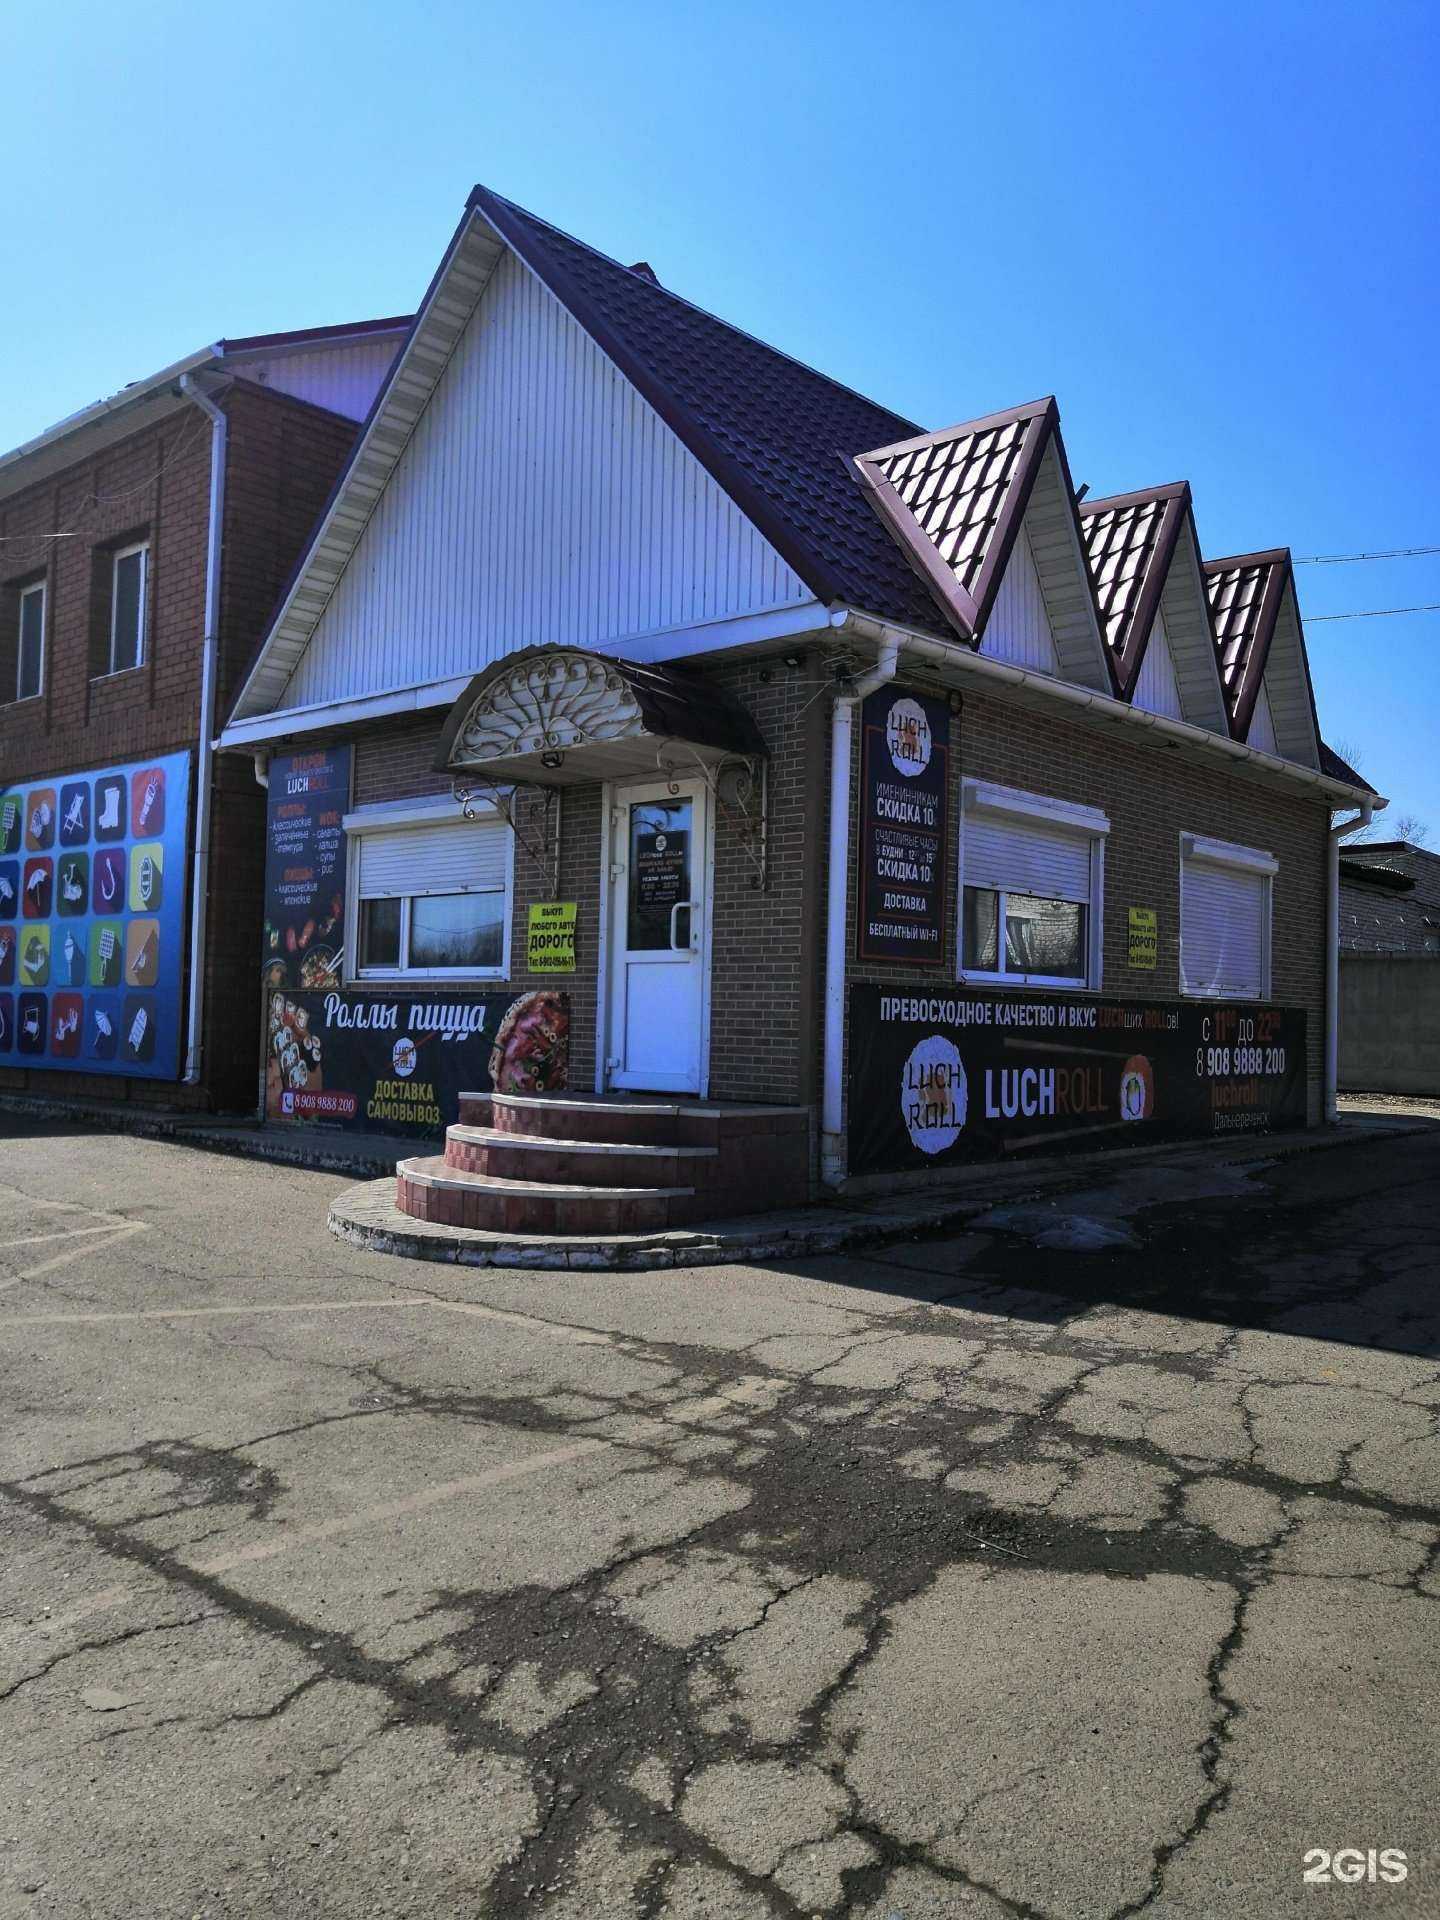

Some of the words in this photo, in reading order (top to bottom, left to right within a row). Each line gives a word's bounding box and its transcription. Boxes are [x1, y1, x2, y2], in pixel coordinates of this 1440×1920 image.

[890, 711, 927, 738] LUCH
[891, 740, 926, 765] ROLL
[876, 782, 938, 809] ИМЕНИННИКАМ
[876, 797, 920, 824] СКИДКА
[874, 828, 919, 848] СЧАСТЛИВЫЕ
[919, 837, 938, 851] ЧАСЫ
[882, 844, 904, 859] БУДНИ
[877, 858, 918, 881] СКИДКА
[883, 892, 927, 912] ДОСТАВКА
[869, 921, 918, 940] БЕСПЛАТНЫЙ
[919, 927, 938, 941] WI-FI
[323, 992, 398, 1031] Роллы
[407, 1003, 487, 1041] пицца
[880, 996, 992, 1027] ПРЕВОСХОДНОЕ
[995, 1002, 1055, 1027] КАЧЕСТВО
[1058, 1005, 1066, 1027] И
[1069, 1006, 1097, 1027] ВКУС
[1202, 1017, 1210, 1042] С
[1237, 1018, 1254, 1046] ДО
[1196, 1048, 1204, 1077] 8
[1207, 1047, 1230, 1077] 908
[1233, 1047, 1263, 1076] 9888
[1265, 1047, 1286, 1075] 200
[908, 1063, 961, 1090] LUCH
[294, 1093, 301, 1107] 8
[302, 1094, 316, 1110] 908
[317, 1095, 338, 1112] 9888
[338, 1096, 354, 1113] 200
[373, 1079, 434, 1102] ДОСТАВКА
[366, 1099, 440, 1124] САМОВЫВОЗ
[908, 1103, 964, 1130] ROLL
